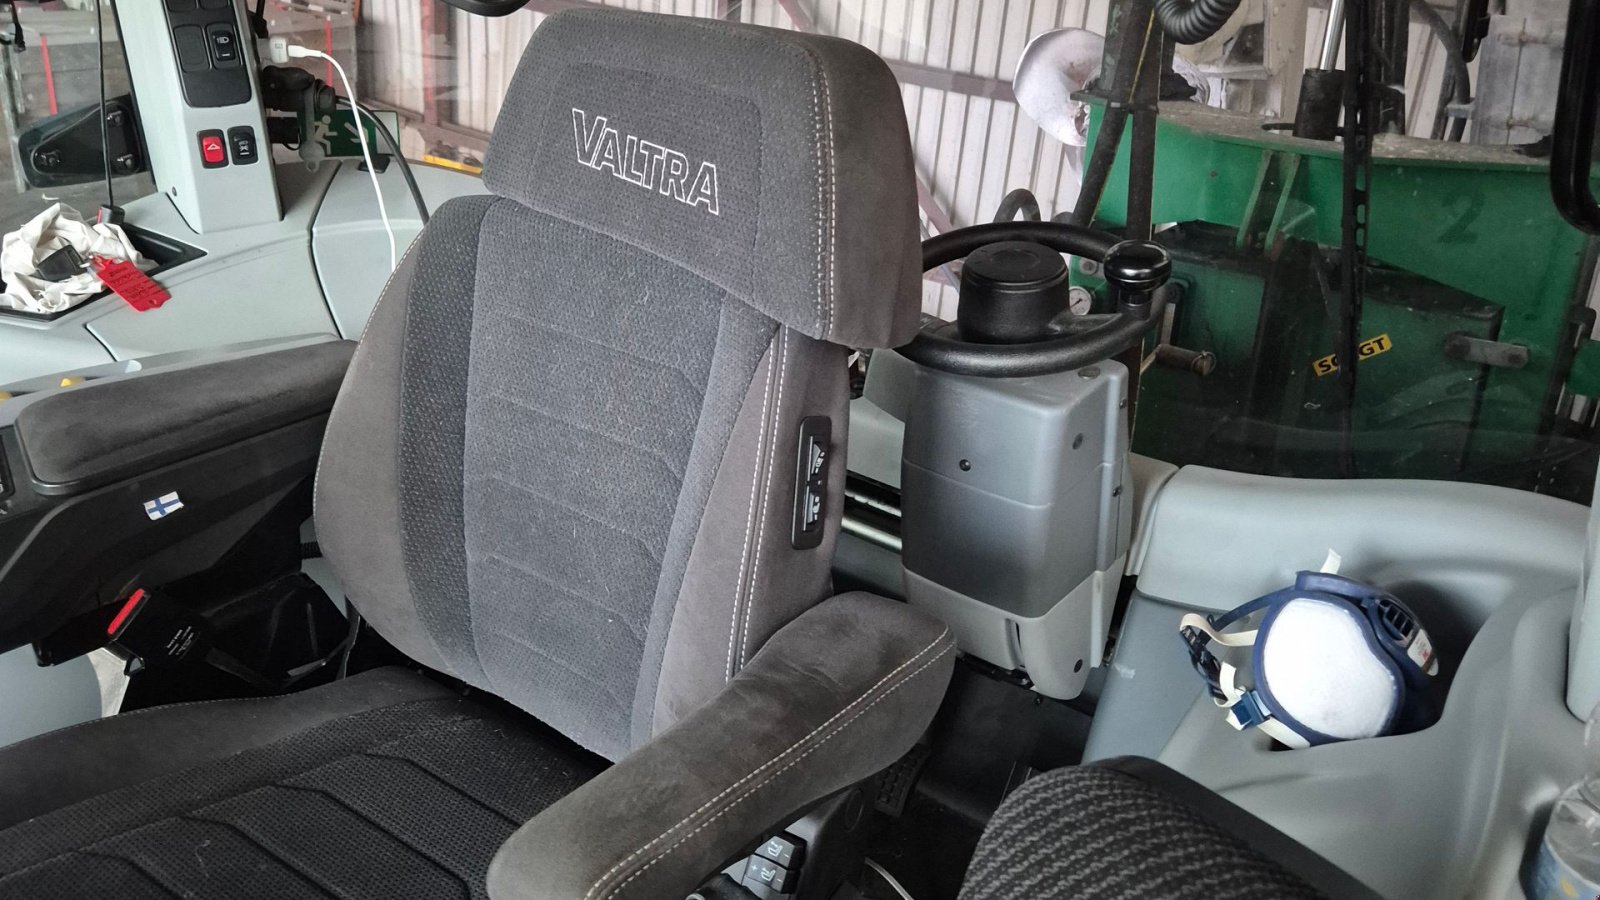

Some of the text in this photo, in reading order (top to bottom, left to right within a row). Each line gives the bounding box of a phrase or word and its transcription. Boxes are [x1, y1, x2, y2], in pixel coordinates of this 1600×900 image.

[572, 107, 720, 215] VALTRA
[1437, 189, 1484, 244] 2
[1318, 337, 1384, 373] SGT
